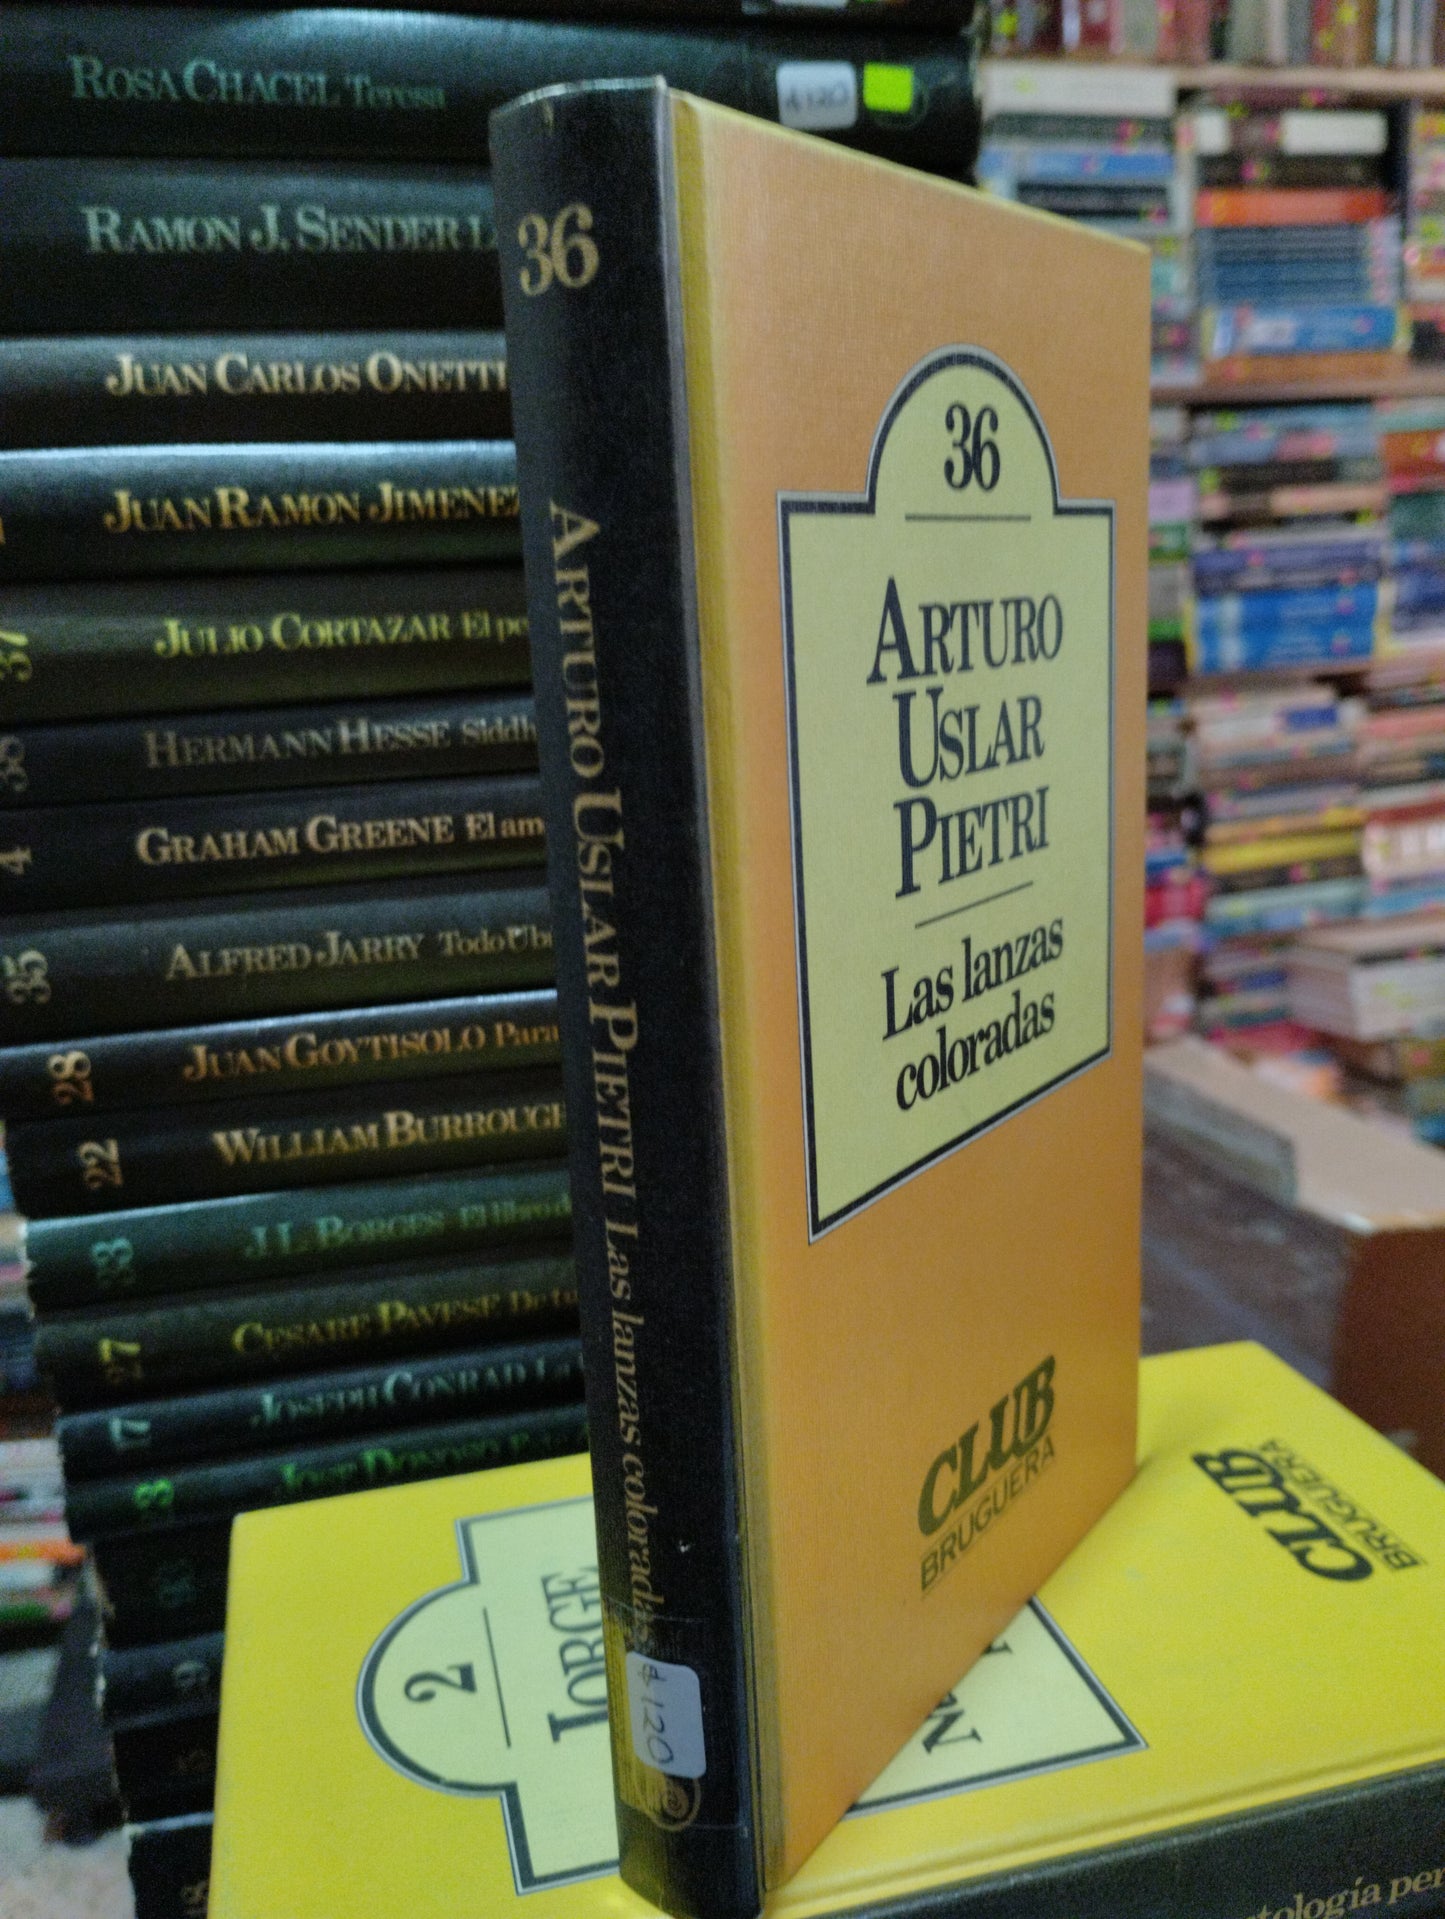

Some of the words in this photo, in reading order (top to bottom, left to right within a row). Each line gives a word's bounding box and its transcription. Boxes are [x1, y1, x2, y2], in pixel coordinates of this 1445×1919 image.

[68, 54, 180, 101] ROSA
[183, 58, 340, 107] CHACEL
[82, 205, 241, 253] RAMON
[300, 204, 460, 251] SENDER
[518, 203, 599, 296] 36
[106, 354, 206, 395] JUAN
[216, 352, 361, 393] CARLOS
[943, 401, 1000, 492] 36
[105, 489, 208, 533] JUAN
[216, 486, 361, 529] RAMON
[154, 617, 263, 657] JULIO
[271, 612, 450, 652] CORTAZAR
[550, 500, 605, 779] ARTURO
[866, 576, 1064, 685] ARTURO
[145, 727, 333, 768] HERMANN
[332, 718, 452, 755] HESSE
[892, 684, 1045, 789] USLAR
[136, 825, 300, 865] GRAHAM
[305, 813, 455, 853] GREENE
[465, 812, 496, 842] El
[893, 785, 1050, 899] PIETRI
[572, 788, 625, 988] USLAR
[165, 943, 311, 980] ALFRED
[313, 930, 425, 966] JARRY
[880, 965, 955, 1042] Las
[961, 916, 1064, 1003] lanzas
[48, 1051, 95, 1105] 28
[182, 1044, 282, 1081] JUAN
[284, 1024, 486, 1069] GOYTISOLO
[896, 989, 1055, 1111] coloradas
[588, 997, 638, 1200] PIETRI
[78, 1139, 123, 1188] 22
[212, 1122, 380, 1166] WILLIAM
[605, 1217, 639, 1301] Las
[384, 1361, 527, 1402] CONRAD
[611, 1306, 645, 1447] lanzas
[918, 1355, 1056, 1537] CLUB
[921, 1435, 1056, 1592] BRUGUERA
[1192, 1448, 1373, 1582] CLUB
[1259, 1438, 1422, 1571] BRUGUERA
[403, 1662, 477, 1704] 2
